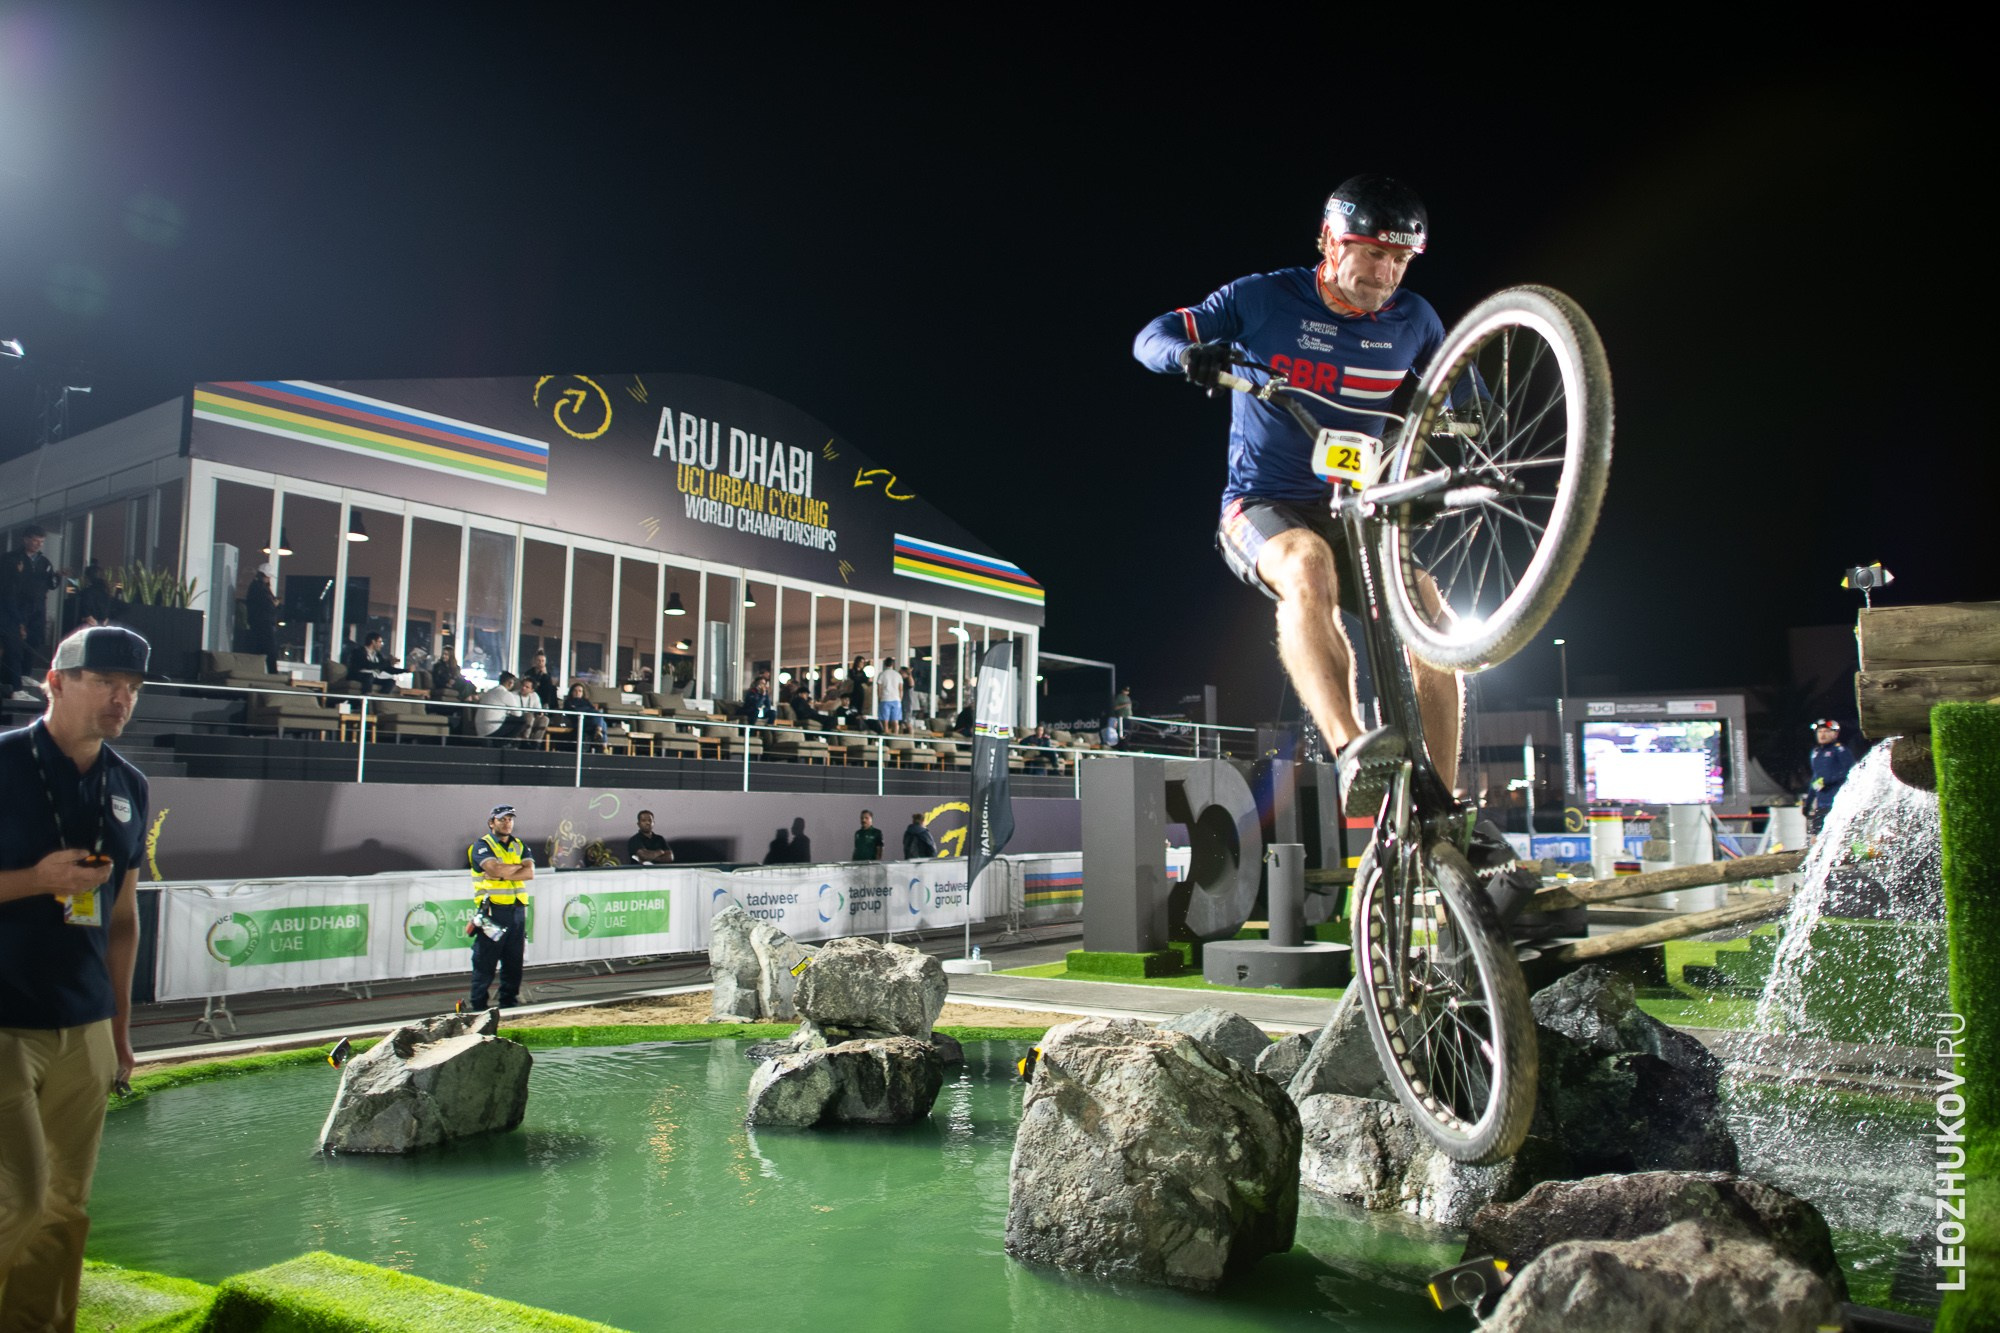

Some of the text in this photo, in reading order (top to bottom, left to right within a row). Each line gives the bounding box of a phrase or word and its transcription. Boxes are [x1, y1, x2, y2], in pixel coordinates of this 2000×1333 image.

[1388, 231, 1425, 246] SALTRO
[1309, 320, 1338, 331] BRITISH
[1309, 326, 1337, 336] CYCLING
[1271, 354, 1339, 394] GBR
[653, 406, 813, 498] ABU DHABI
[677, 463, 829, 528] UCI URBAN CYCLING
[684, 493, 837, 552] WORLD CHAMPIONSHIPS
[1593, 704, 1613, 713] UCI
[1054, 720, 1072, 730] abu
[1073, 718, 1100, 729] dhabi
[1625, 822, 1651, 834] DHAB
[849, 885, 893, 898] tadweer
[934, 881, 968, 893] tadwee
[603, 898, 665, 913] ABU DHABI
[746, 892, 799, 906] tadweer
[935, 895, 962, 909] group
[849, 899, 882, 915] group
[216, 914, 233, 925] UCI
[454, 908, 477, 922] AB
[604, 915, 627, 929] UAE
[270, 914, 360, 934] ABU DHABI
[270, 936, 303, 952] UAE
